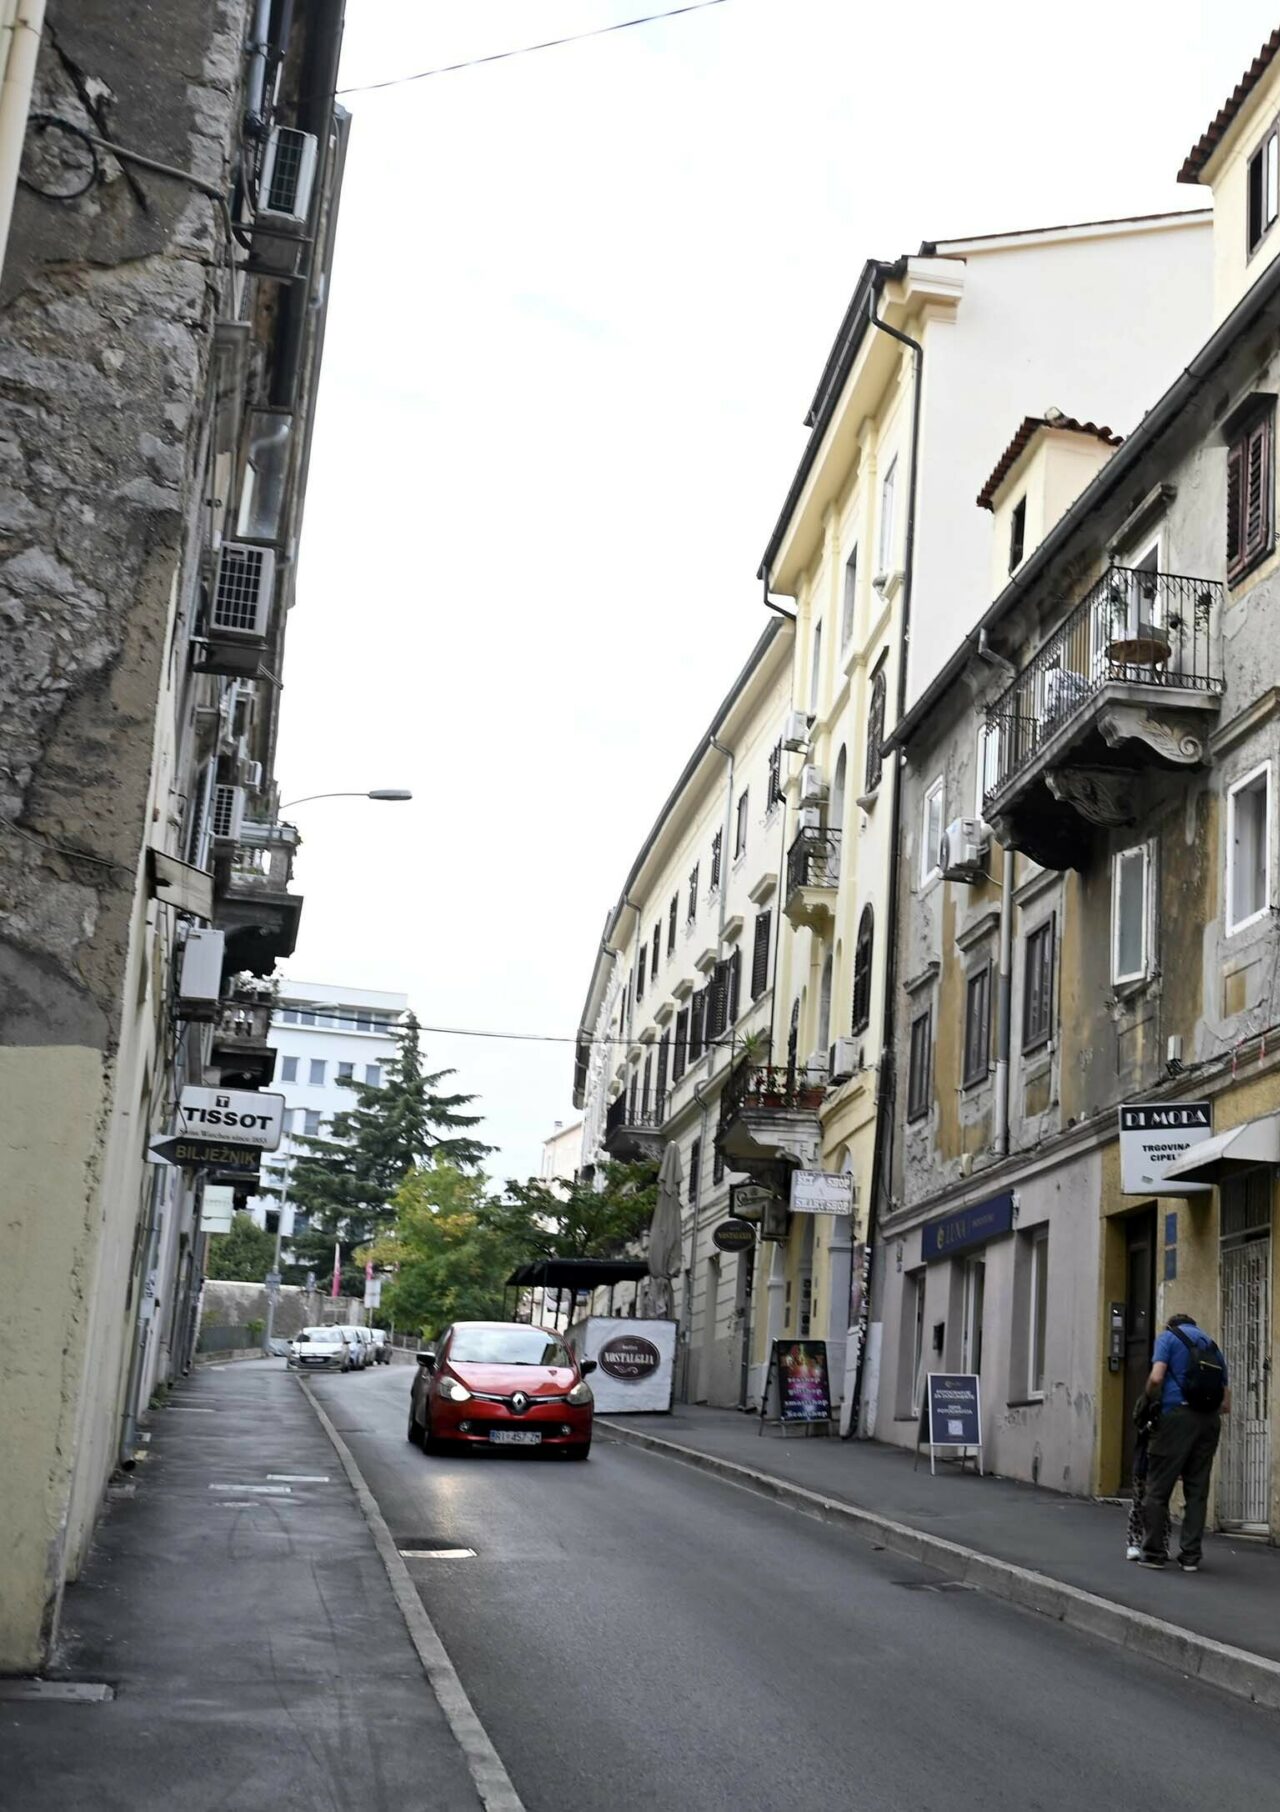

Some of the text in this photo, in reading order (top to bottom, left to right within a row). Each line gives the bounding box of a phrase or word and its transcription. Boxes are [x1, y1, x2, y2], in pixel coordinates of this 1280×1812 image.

[183, 1106, 273, 1130] TISSOT
[1125, 1109, 1207, 1127] DI MODA
[175, 1144, 257, 1165] BILJEŽNIK
[1142, 1143, 1191, 1153] TRGOVINA
[1150, 1153, 1182, 1162] CIPEL
